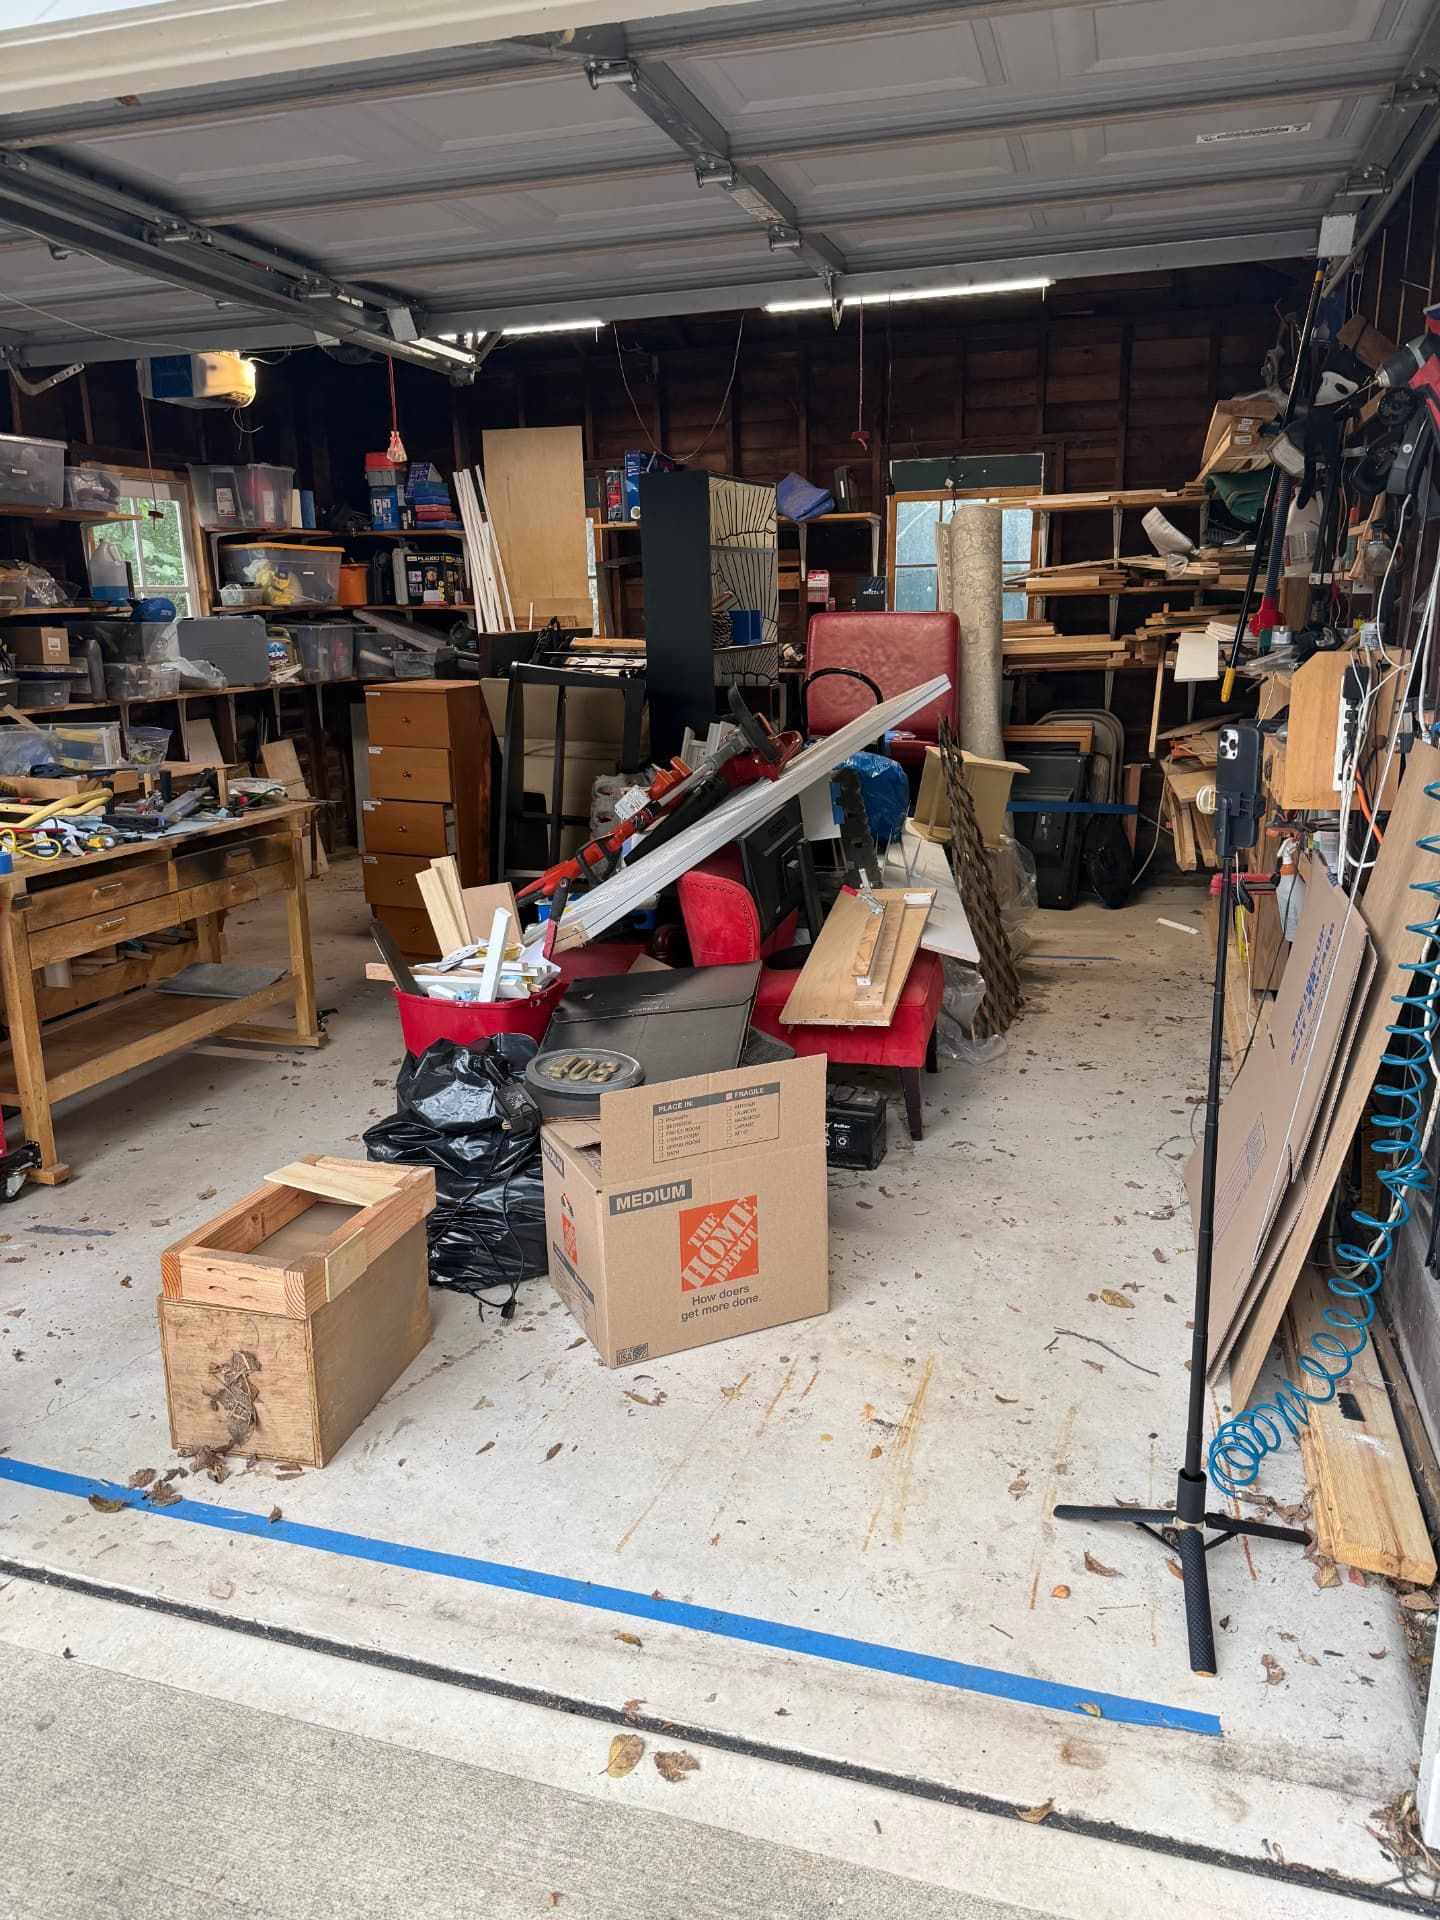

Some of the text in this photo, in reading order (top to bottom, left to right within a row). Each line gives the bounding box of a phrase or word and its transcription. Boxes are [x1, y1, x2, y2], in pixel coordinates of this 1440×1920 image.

[548, 1056, 620, 1084] 408
[734, 1087, 765, 1098] FRAGILE
[658, 1102, 682, 1113] PLACE
[616, 1184, 686, 1211] MEDIUM
[682, 1197, 758, 1288] HOME
[687, 1212, 720, 1248] THE
[712, 1225, 759, 1282] DEPOT
[692, 1285, 750, 1306] How doers
[681, 1308, 700, 1323] get
[701, 1302, 730, 1316] more
